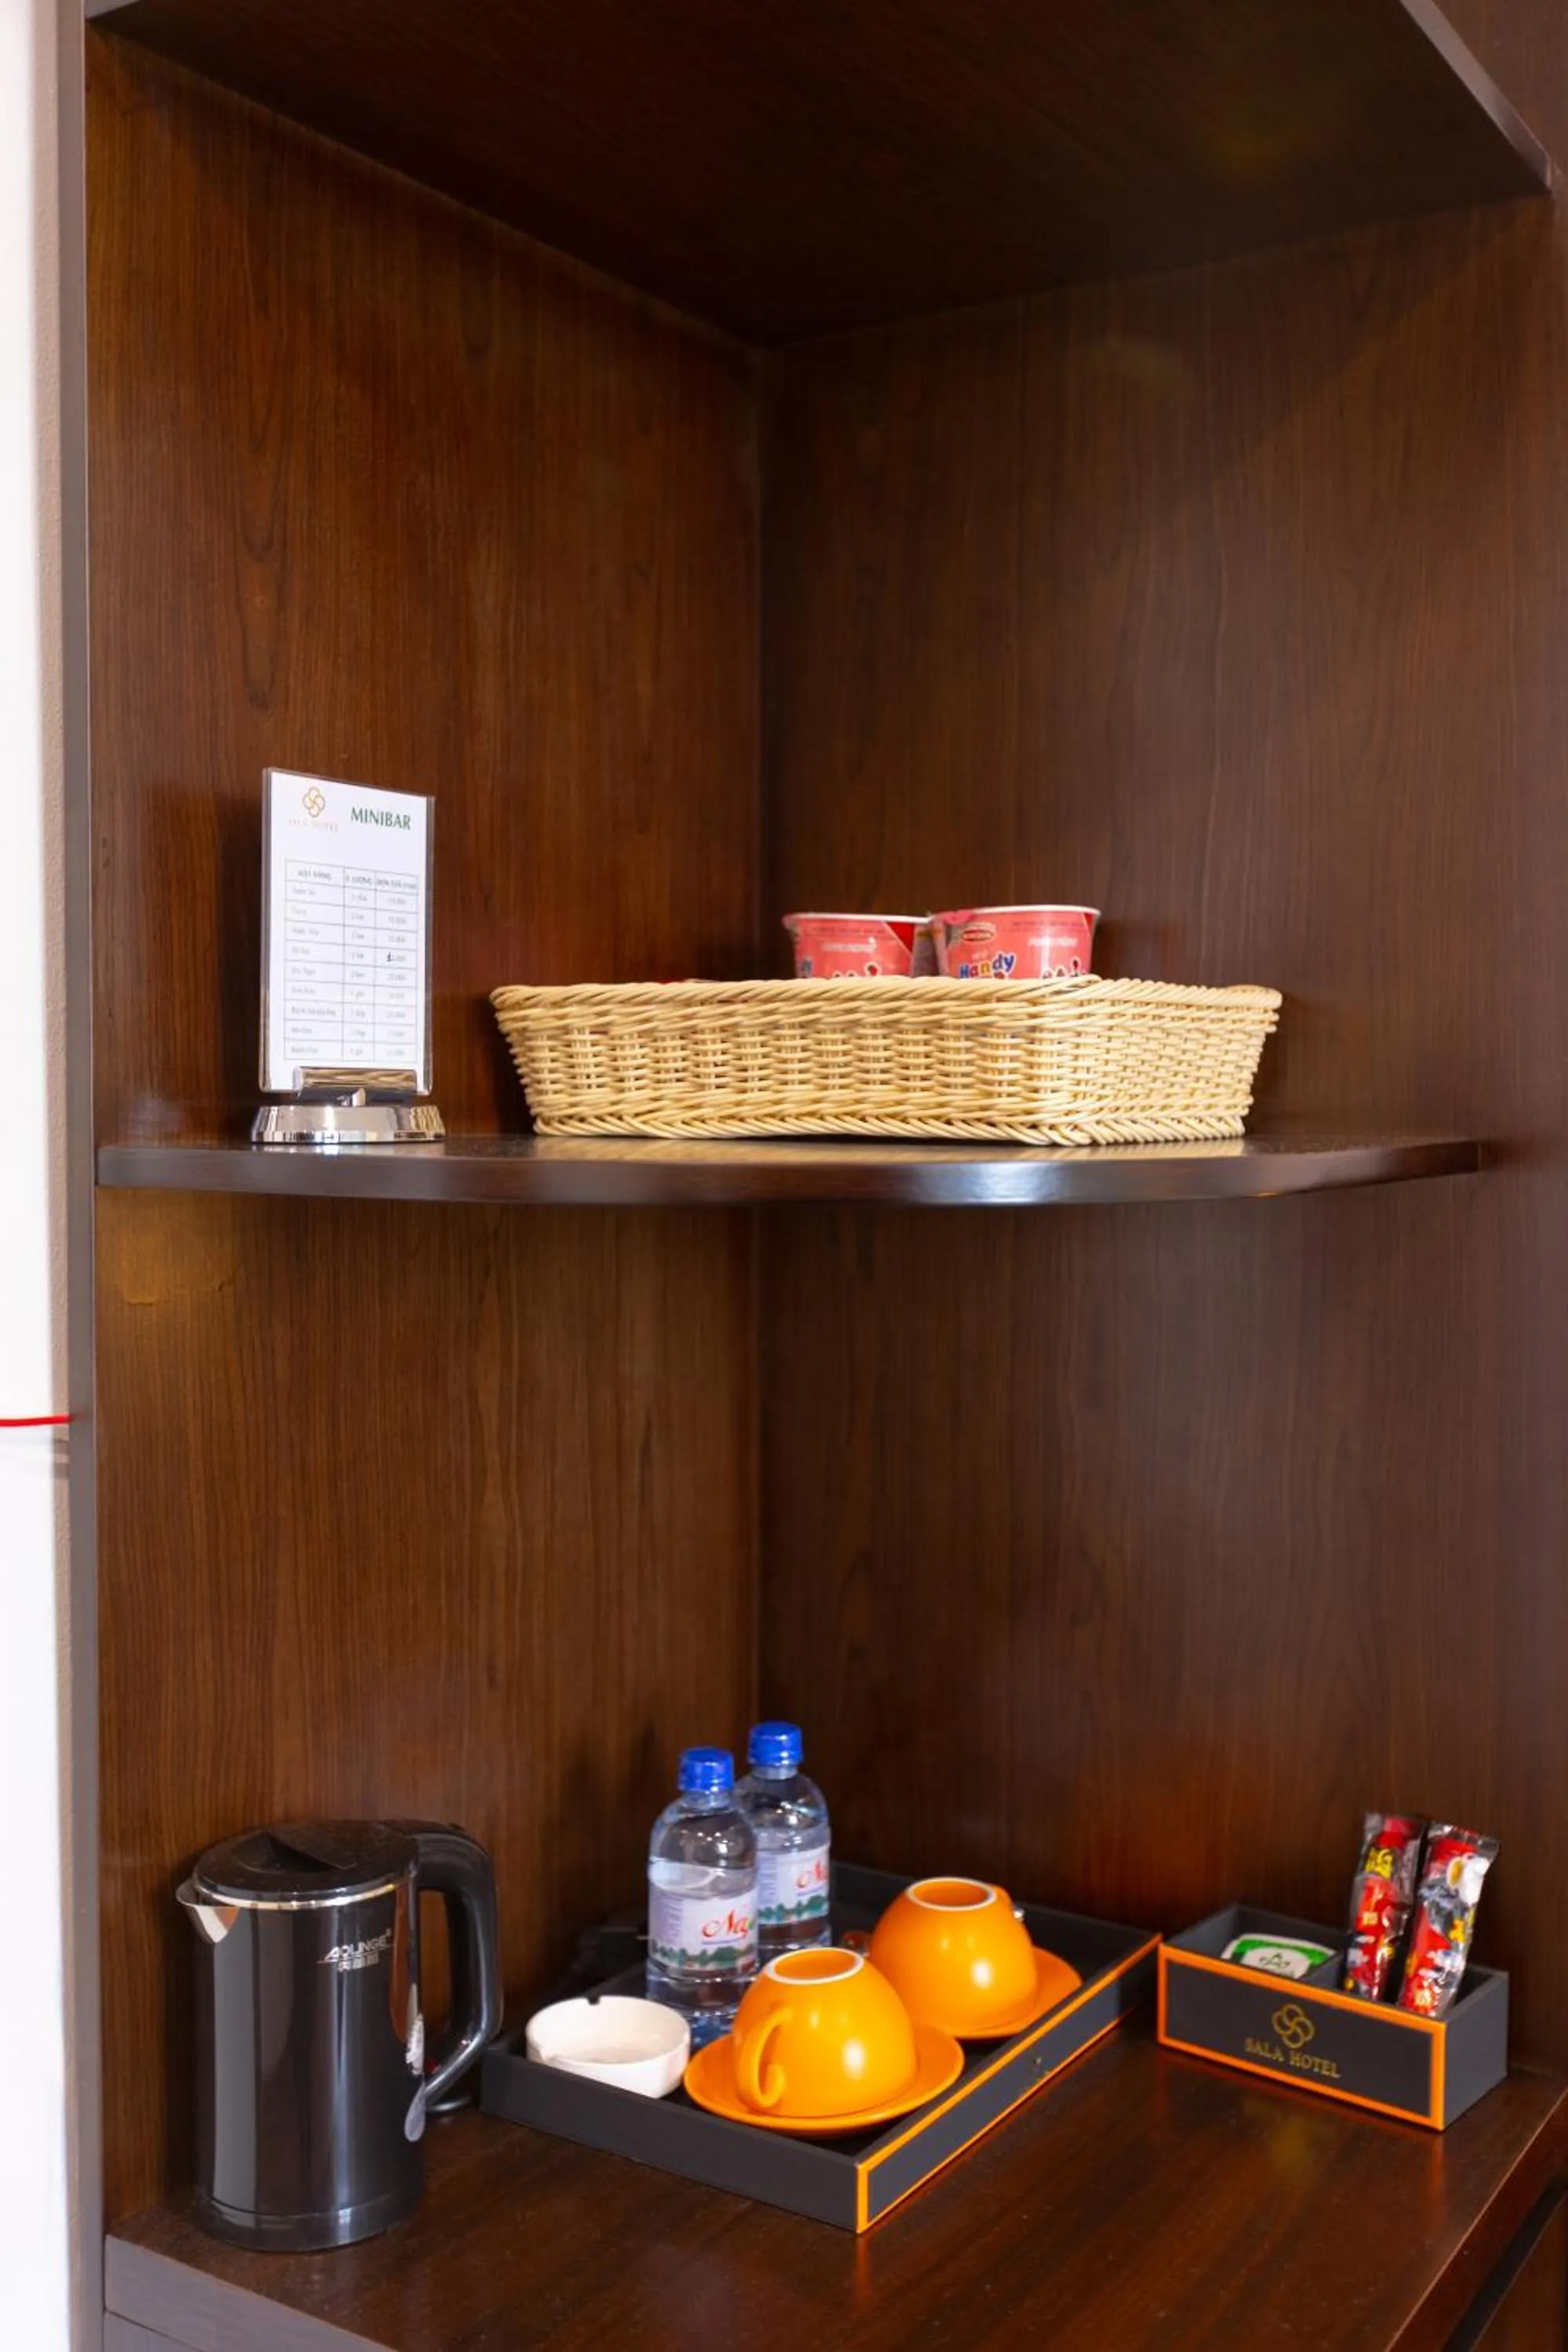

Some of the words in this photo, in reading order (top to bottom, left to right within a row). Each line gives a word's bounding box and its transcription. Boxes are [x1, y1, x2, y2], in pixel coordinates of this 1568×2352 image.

[350, 807, 412, 830] MINIBAR
[959, 952, 1015, 979] Handy
[1245, 2038, 1285, 2062] SALA
[1289, 2049, 1341, 2079] HOTEL
